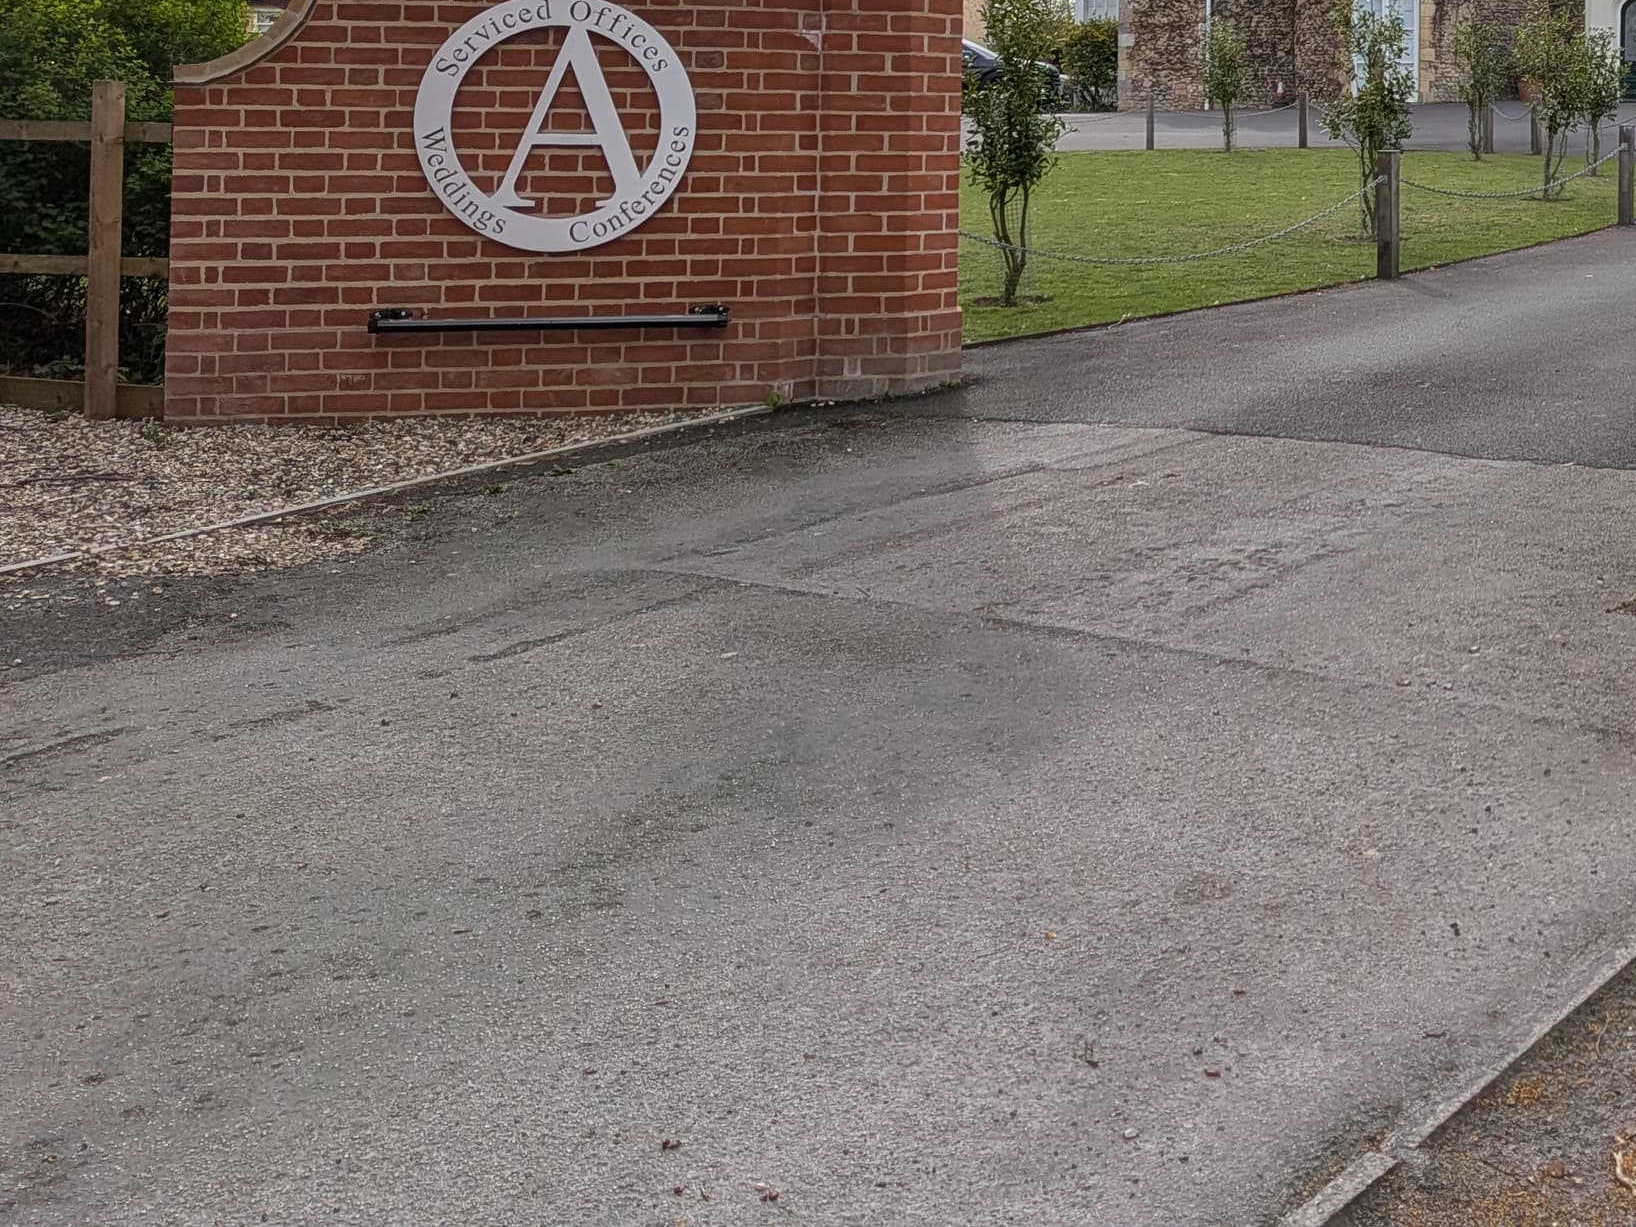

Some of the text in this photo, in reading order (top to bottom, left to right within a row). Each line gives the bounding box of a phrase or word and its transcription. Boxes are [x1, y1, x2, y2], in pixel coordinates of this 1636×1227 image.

[569, 0, 669, 73] Offices
[489, 25, 641, 207] A
[421, 126, 507, 235] Weddings
[568, 125, 690, 244] Conferences
